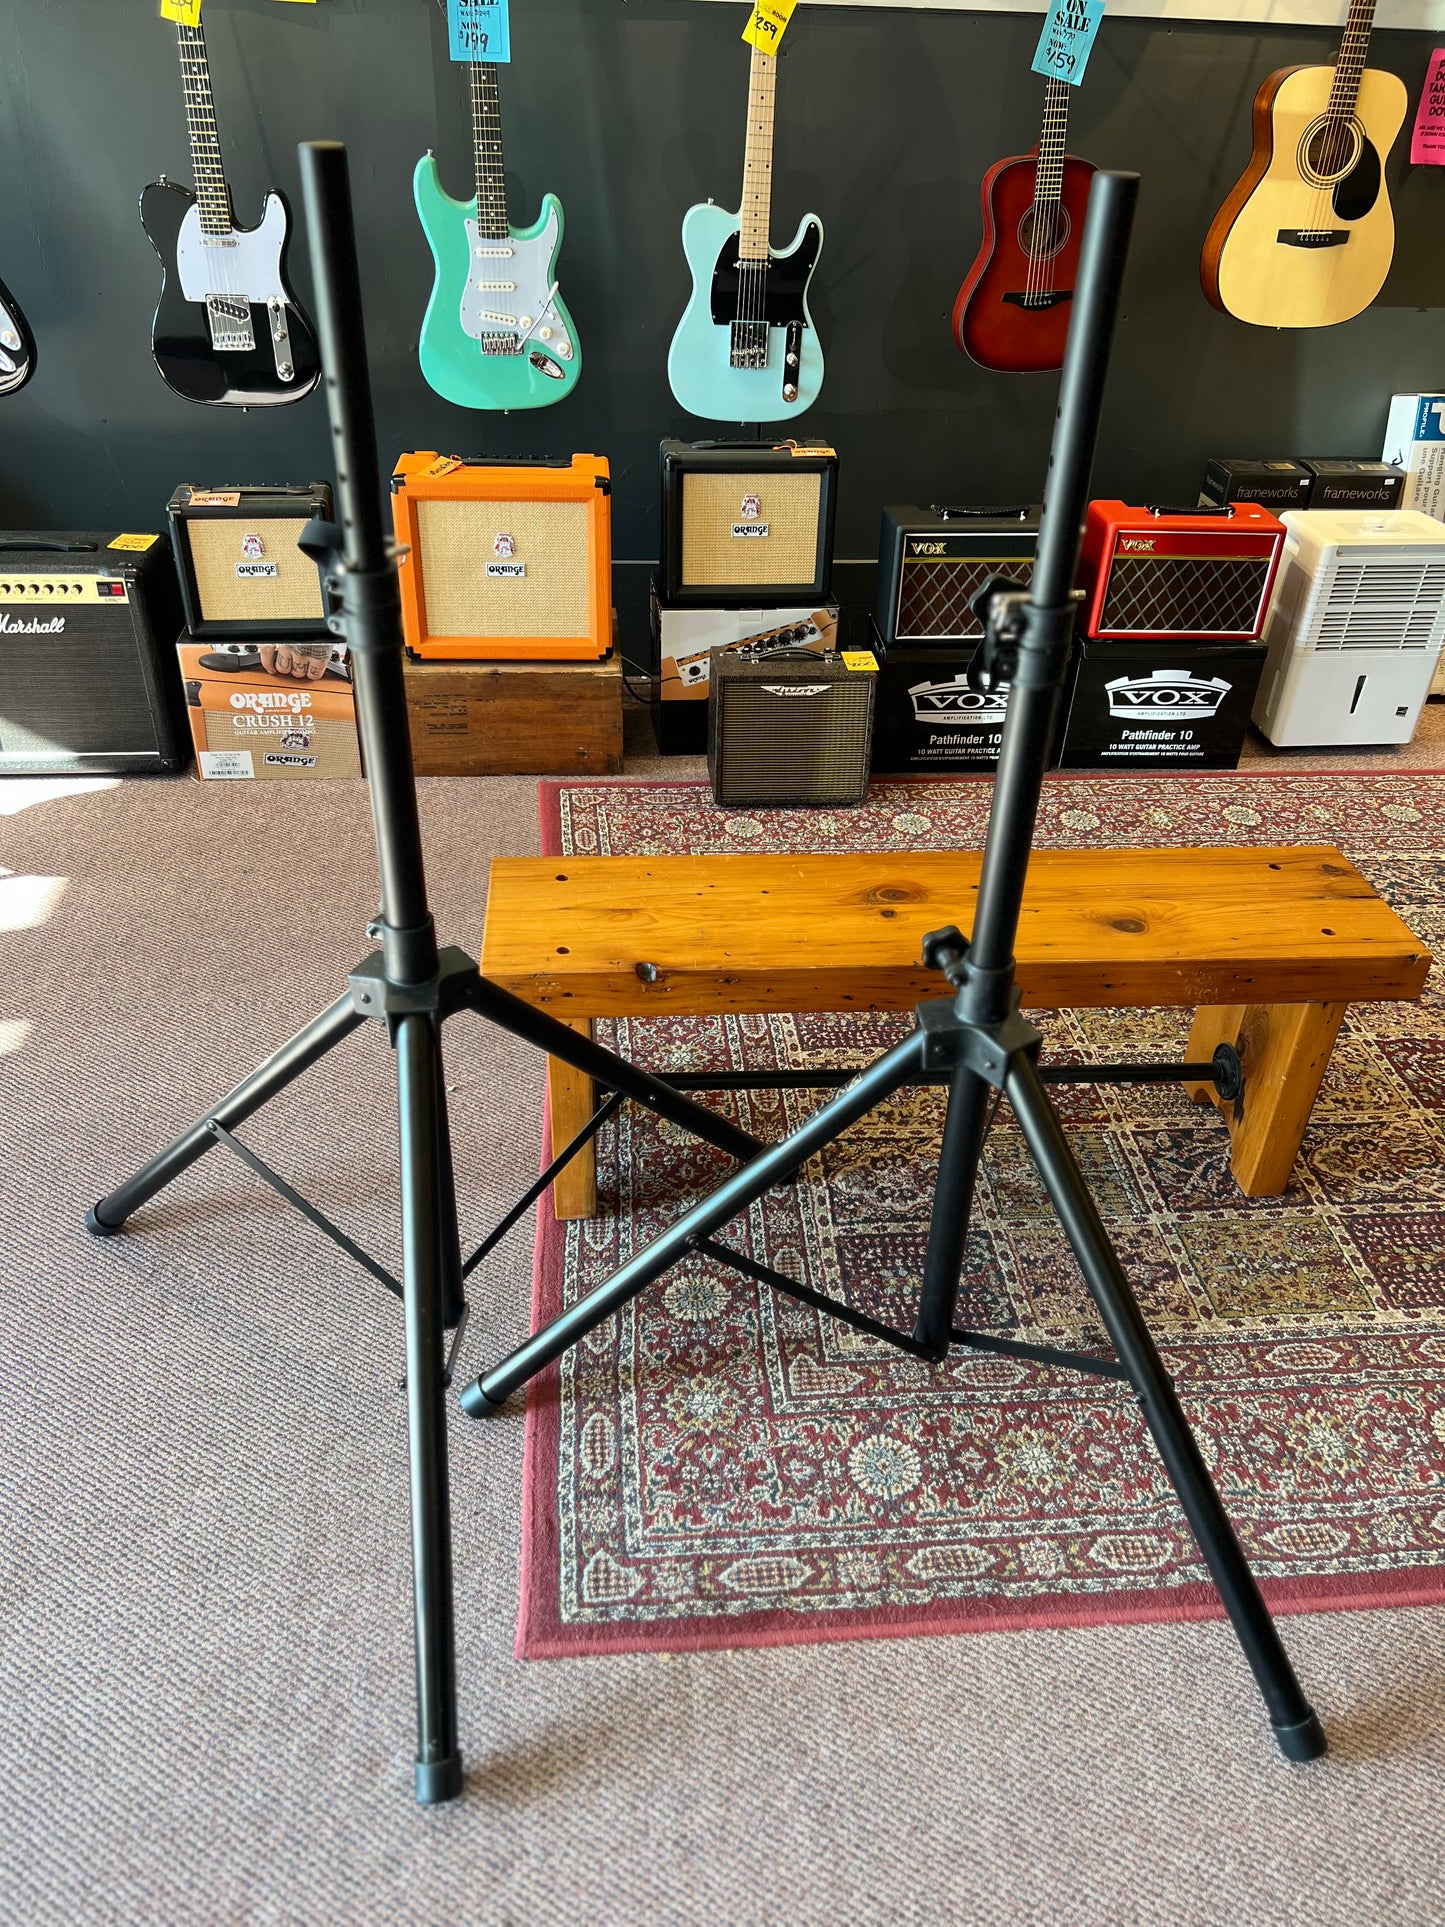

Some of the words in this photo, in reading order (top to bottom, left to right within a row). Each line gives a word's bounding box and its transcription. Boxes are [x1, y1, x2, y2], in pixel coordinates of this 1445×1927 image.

[1066, 0, 1087, 16] ON
[1054, 11, 1091, 32] SALE
[1426, 447, 1438, 485] Support
[1236, 486, 1299, 499] frameworks
[1323, 486, 1390, 500] frameworks
[734, 526, 767, 536] ORANGE
[911, 542, 947, 554] VOX
[1121, 539, 1156, 551] VOX
[239, 565, 275, 576] ORANGE
[488, 565, 524, 575] ORANGE
[230, 693, 312, 713] ORANGE
[924, 693, 1008, 708] VOX
[1120, 689, 1212, 705] VOX
[233, 715, 294, 728] CRUSH
[299, 715, 314, 727] 12
[929, 735, 984, 745] Pathfinder
[988, 734, 1002, 744] 10
[1121, 730, 1176, 740] Pathfinder
[1179, 730, 1193, 740] 10
[266, 755, 315, 766] ORANGE
